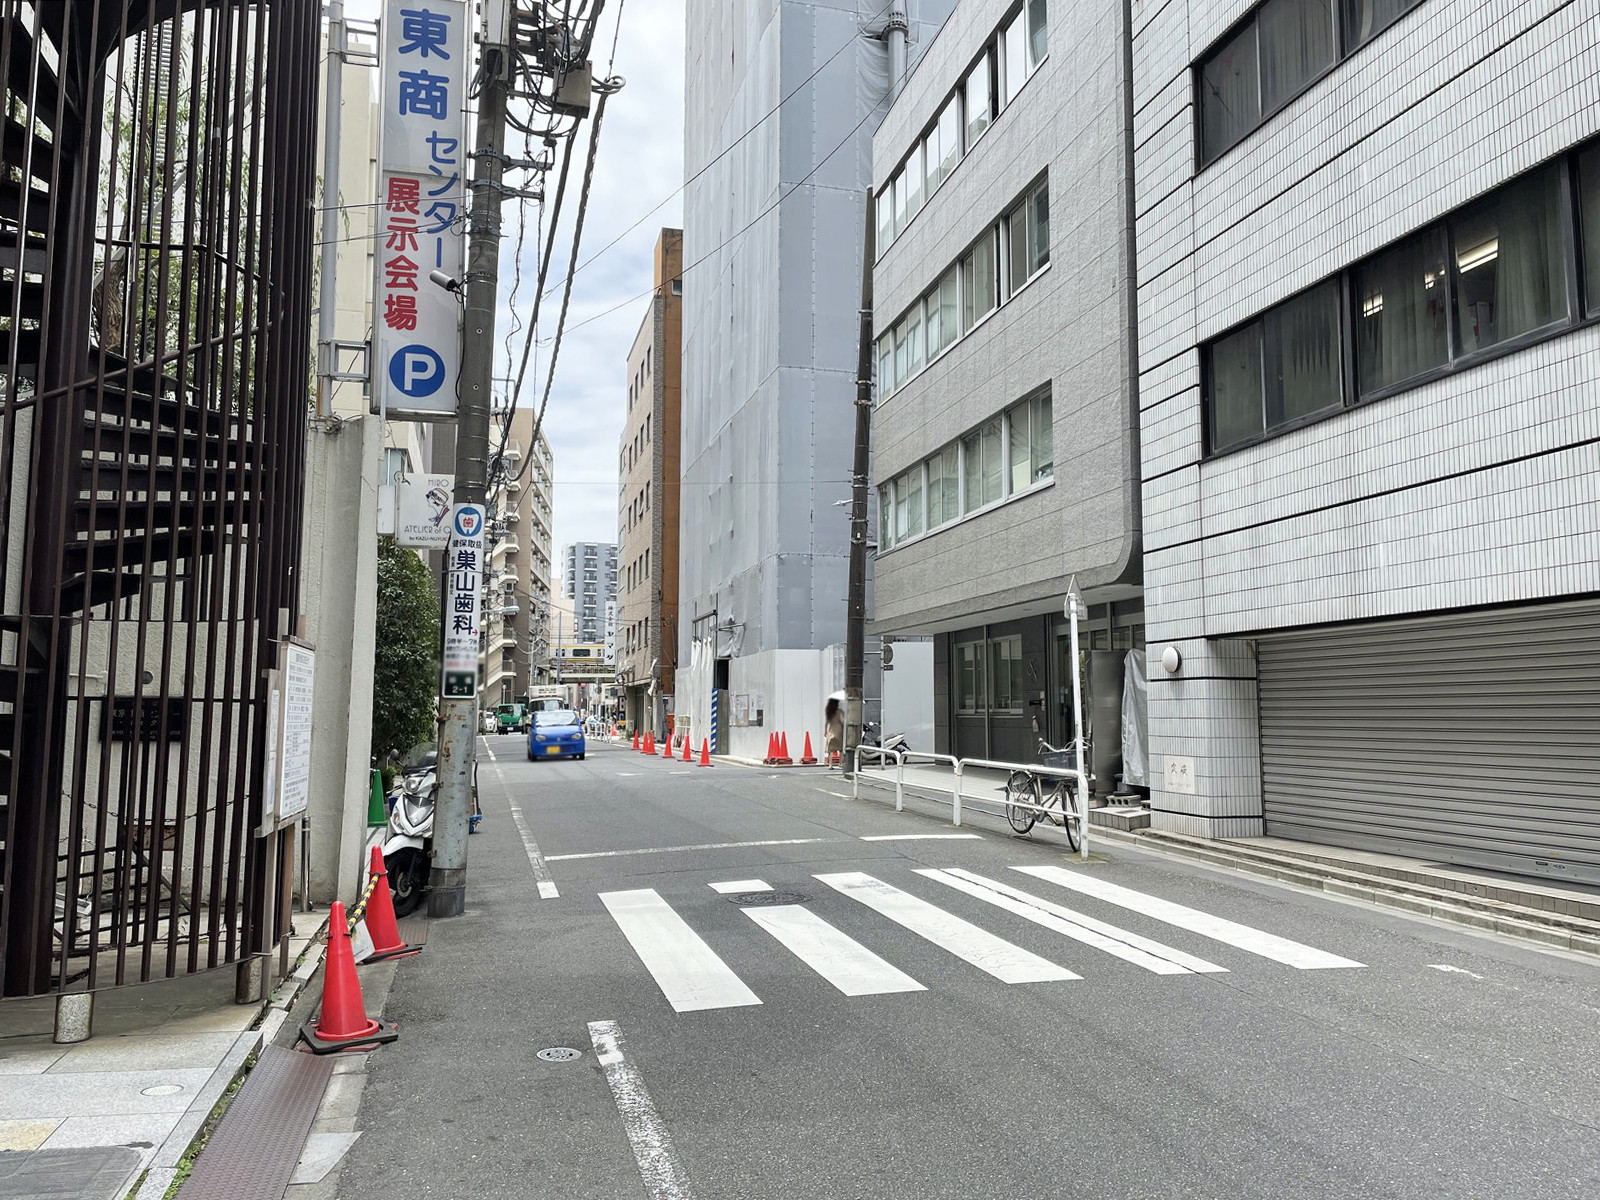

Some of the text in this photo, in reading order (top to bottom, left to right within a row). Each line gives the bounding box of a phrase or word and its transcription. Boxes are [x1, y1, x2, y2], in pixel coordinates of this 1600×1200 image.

[398, 8, 458, 268] 東商 センター
[383, 177, 421, 331] 展示会場
[404, 352, 436, 391] P
[452, 550, 476, 635] 巣山歯科
[452, 685, 468, 694] 2-1
